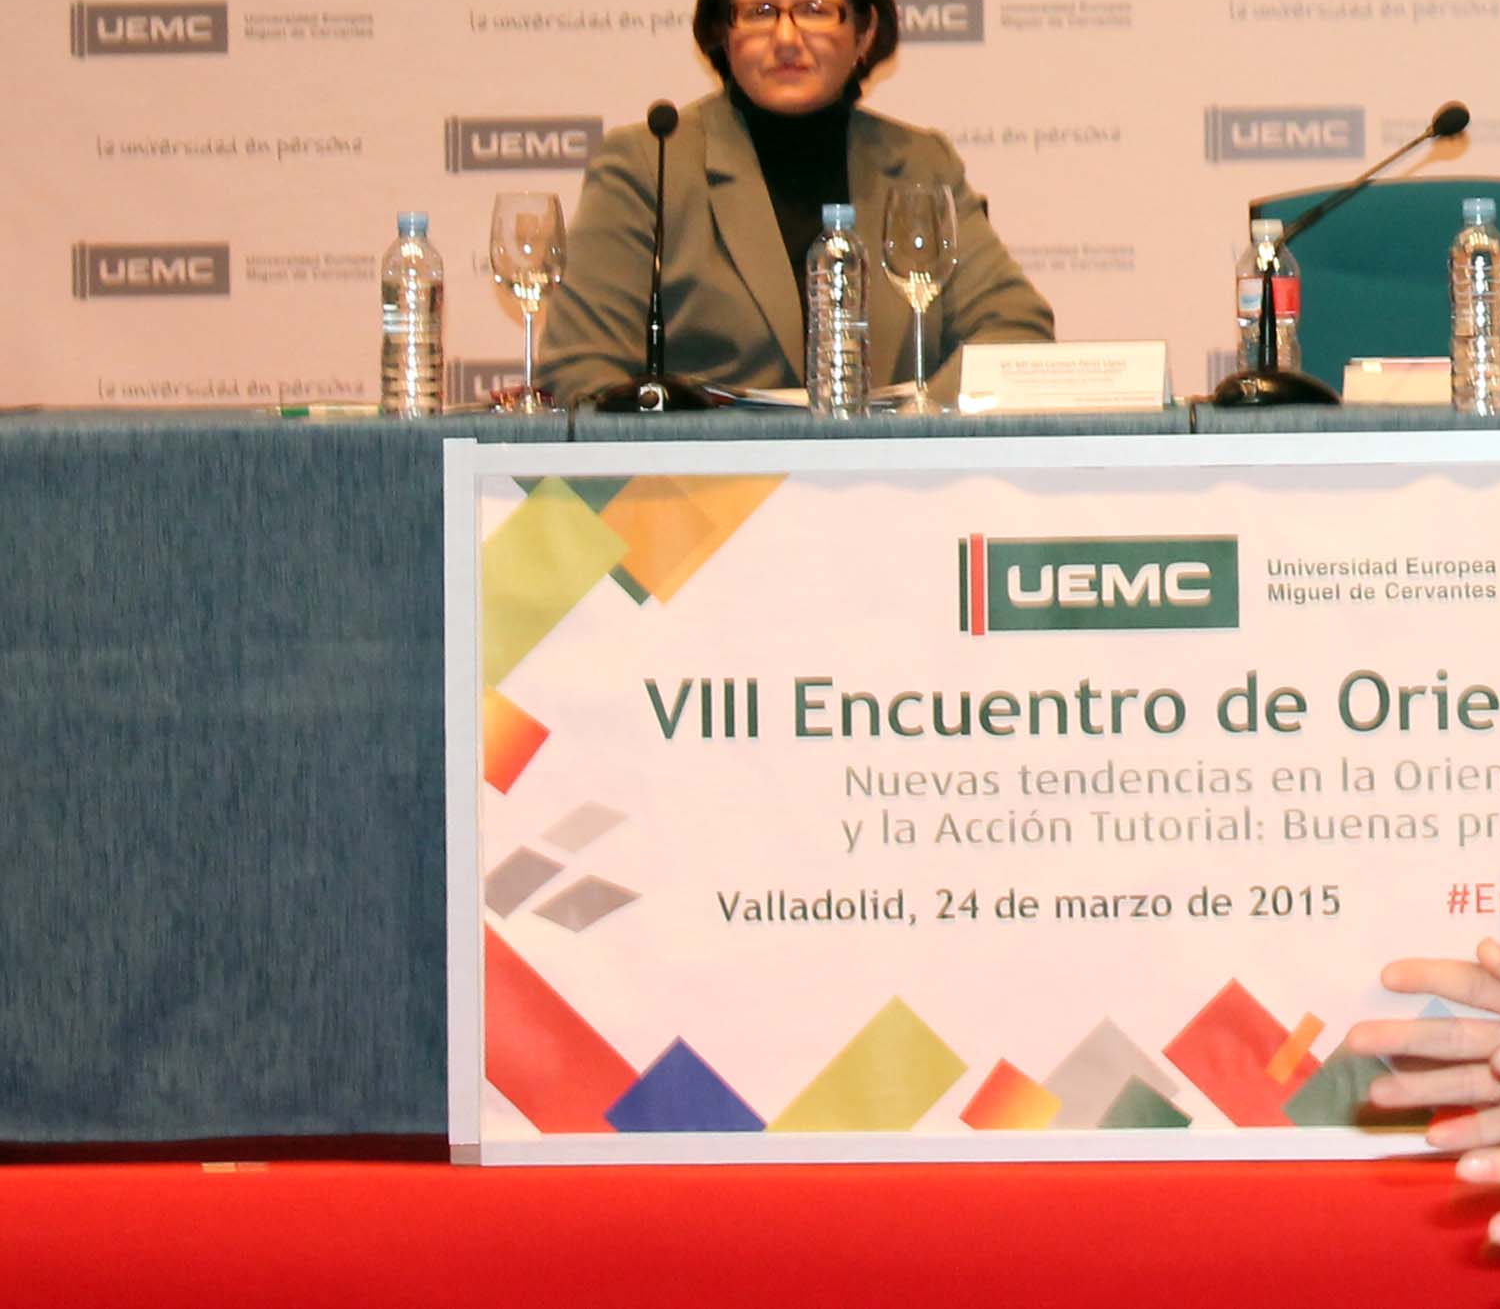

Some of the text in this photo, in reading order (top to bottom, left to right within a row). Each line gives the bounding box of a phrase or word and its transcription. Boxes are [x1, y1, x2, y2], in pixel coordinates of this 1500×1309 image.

[97, 15, 211, 42] UEMC
[471, 130, 587, 157] UEMC
[1231, 120, 1348, 147] UEMC
[99, 257, 213, 284] UEMC
[1267, 557, 1497, 578] Universidad Europea
[1007, 562, 1211, 607] UEMC
[1267, 581, 1497, 605] Miguel de Cervantes
[643, 677, 759, 740] VIII
[794, 676, 1187, 738] Encuentro
[1216, 670, 1308, 734] de
[845, 766, 1000, 798] Nuevas
[1018, 760, 1253, 796] tendencias
[1272, 768, 1322, 793] en
[1342, 757, 1375, 793] la
[841, 818, 863, 853] y
[882, 808, 916, 845] la
[934, 810, 1073, 845] Acción
[1091, 807, 1264, 843] Tutorial:
[1283, 809, 1439, 841] Buenas
[717, 885, 1341, 925] Valladolid, 24 de marzo de 2015
